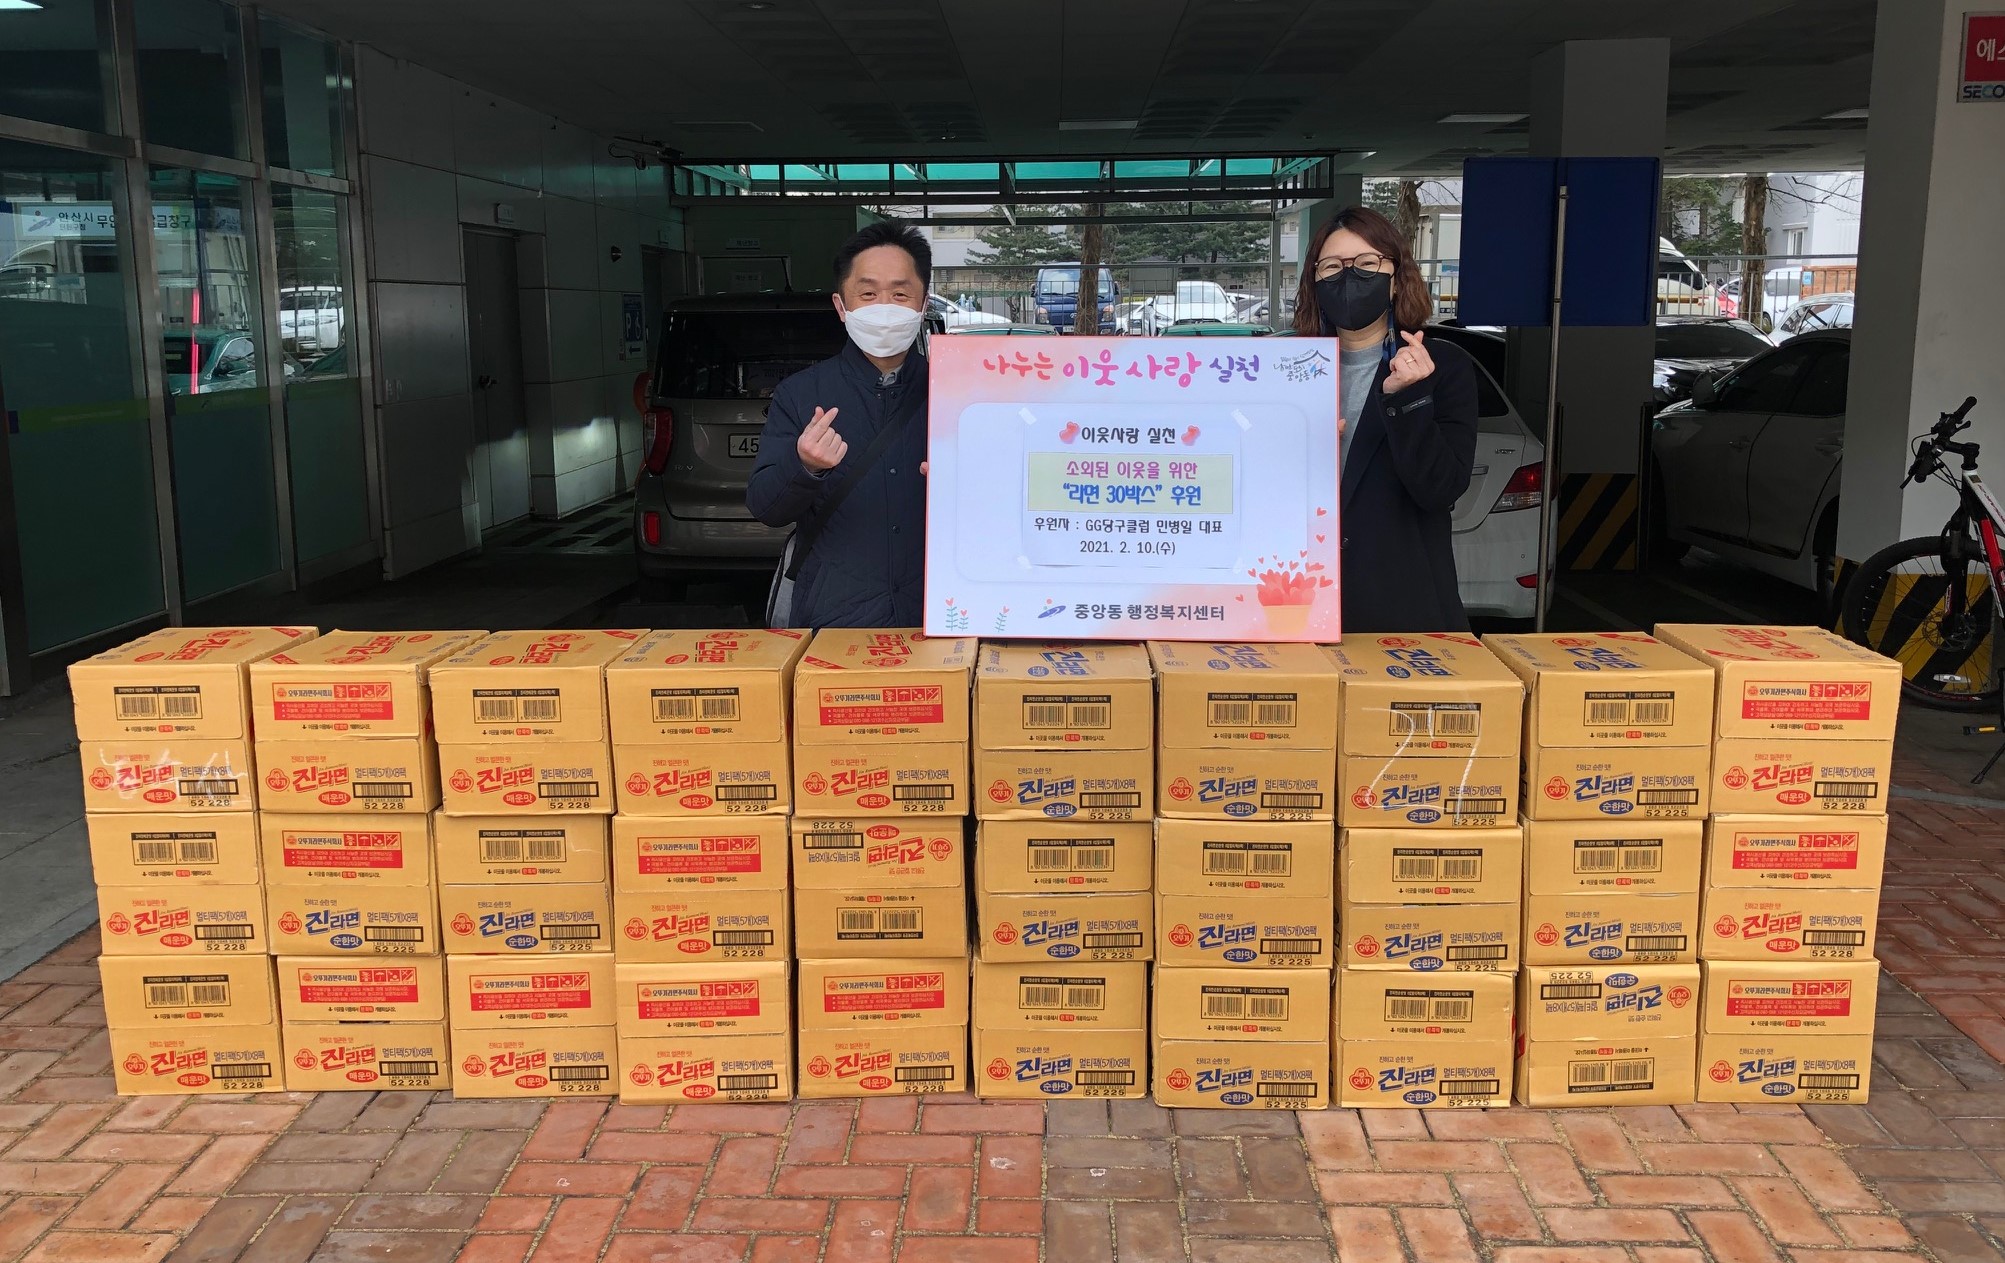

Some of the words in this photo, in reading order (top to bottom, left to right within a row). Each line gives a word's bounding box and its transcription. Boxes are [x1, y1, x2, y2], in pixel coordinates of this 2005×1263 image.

[59, 212, 93, 222] 안산시
[984, 352, 1053, 380] 나누는
[1063, 349, 1119, 385] 이웃
[1126, 352, 1201, 387] 사랑
[1209, 355, 1259, 383] 실천
[1082, 427, 1139, 444] 이웃사랑
[1147, 428, 1175, 444] 실천
[1067, 461, 1108, 478] 소외된
[1117, 462, 1160, 479] 이웃을
[1169, 462, 1197, 479] 위한
[1171, 485, 1201, 506] 후원
[1086, 519, 1149, 533] GG당구클럽
[1157, 520, 1191, 534] 민병일
[1199, 521, 1222, 534] 대표
[1080, 541, 1113, 552] 2021.
[1120, 541, 1130, 553] 2.
[1137, 542, 1175, 555] 10.(수)
[1074, 604, 1122, 619] 중앙동
[1127, 605, 1224, 621] 행정복지센터
[292, 766, 349, 794] 진라면
[477, 766, 534, 794] 진라면
[653, 770, 711, 797] 진라면
[830, 769, 889, 797] 진라면
[1751, 763, 1813, 793] 진라면
[1016, 779, 1076, 804] 진라면
[1198, 778, 1257, 803] 진라면
[1574, 774, 1634, 802] 진라면
[147, 792, 174, 802] 매운맛
[322, 793, 348, 803] 매운맛
[507, 794, 533, 804] 매운맛
[683, 796, 710, 806] 매운맛
[860, 796, 887, 806] 매운맛
[1779, 792, 1808, 803] 매운맛
[1046, 804, 1073, 814] 순한맛
[1226, 803, 1254, 813] 순한맛
[1602, 801, 1630, 812] 순한맛
[1409, 811, 1437, 821] 순한맛
[134, 910, 190, 936] 진라면
[304, 910, 361, 937] 진라면
[478, 911, 537, 937] 진라면
[651, 914, 710, 942] 진라면
[1741, 912, 1802, 941] 진라면
[164, 935, 190, 945] 매운맛
[508, 936, 535, 946] 순한맛
[1022, 920, 1080, 946] 진라면
[1198, 924, 1257, 950] 진라면
[1563, 922, 1623, 948] 진라면
[333, 937, 359, 947] 순한맛
[681, 941, 708, 951] 매운맛
[1050, 945, 1077, 955] 순한맛
[1384, 930, 1443, 956] 진라면
[1769, 940, 1797, 950] 매운맛
[1226, 950, 1254, 960] 순한맛
[1591, 947, 1619, 957] 순한맛
[1412, 956, 1440, 966] 순한맛
[151, 1050, 207, 1076] 진라면
[320, 1046, 376, 1072] 진라면
[489, 1051, 546, 1078] 진라면
[834, 1052, 892, 1079] 진라면
[349, 1071, 375, 1081] 매운맛
[656, 1059, 714, 1088] 진라면
[1015, 1057, 1072, 1082] 진라면
[1737, 1058, 1796, 1085] 진라면
[180, 1075, 207, 1085] 매운맛
[518, 1077, 544, 1087] 매운맛
[863, 1078, 889, 1087] 매운맛
[1042, 1082, 1069, 1092] 순한맛
[1195, 1068, 1253, 1093] 진라면
[1378, 1066, 1436, 1092] 진라면
[687, 1086, 713, 1097] 매운맛
[1223, 1093, 1250, 1102] 순한맛
[1406, 1091, 1433, 1101] 순한맛
[1764, 1085, 1792, 1095] 순한맛
